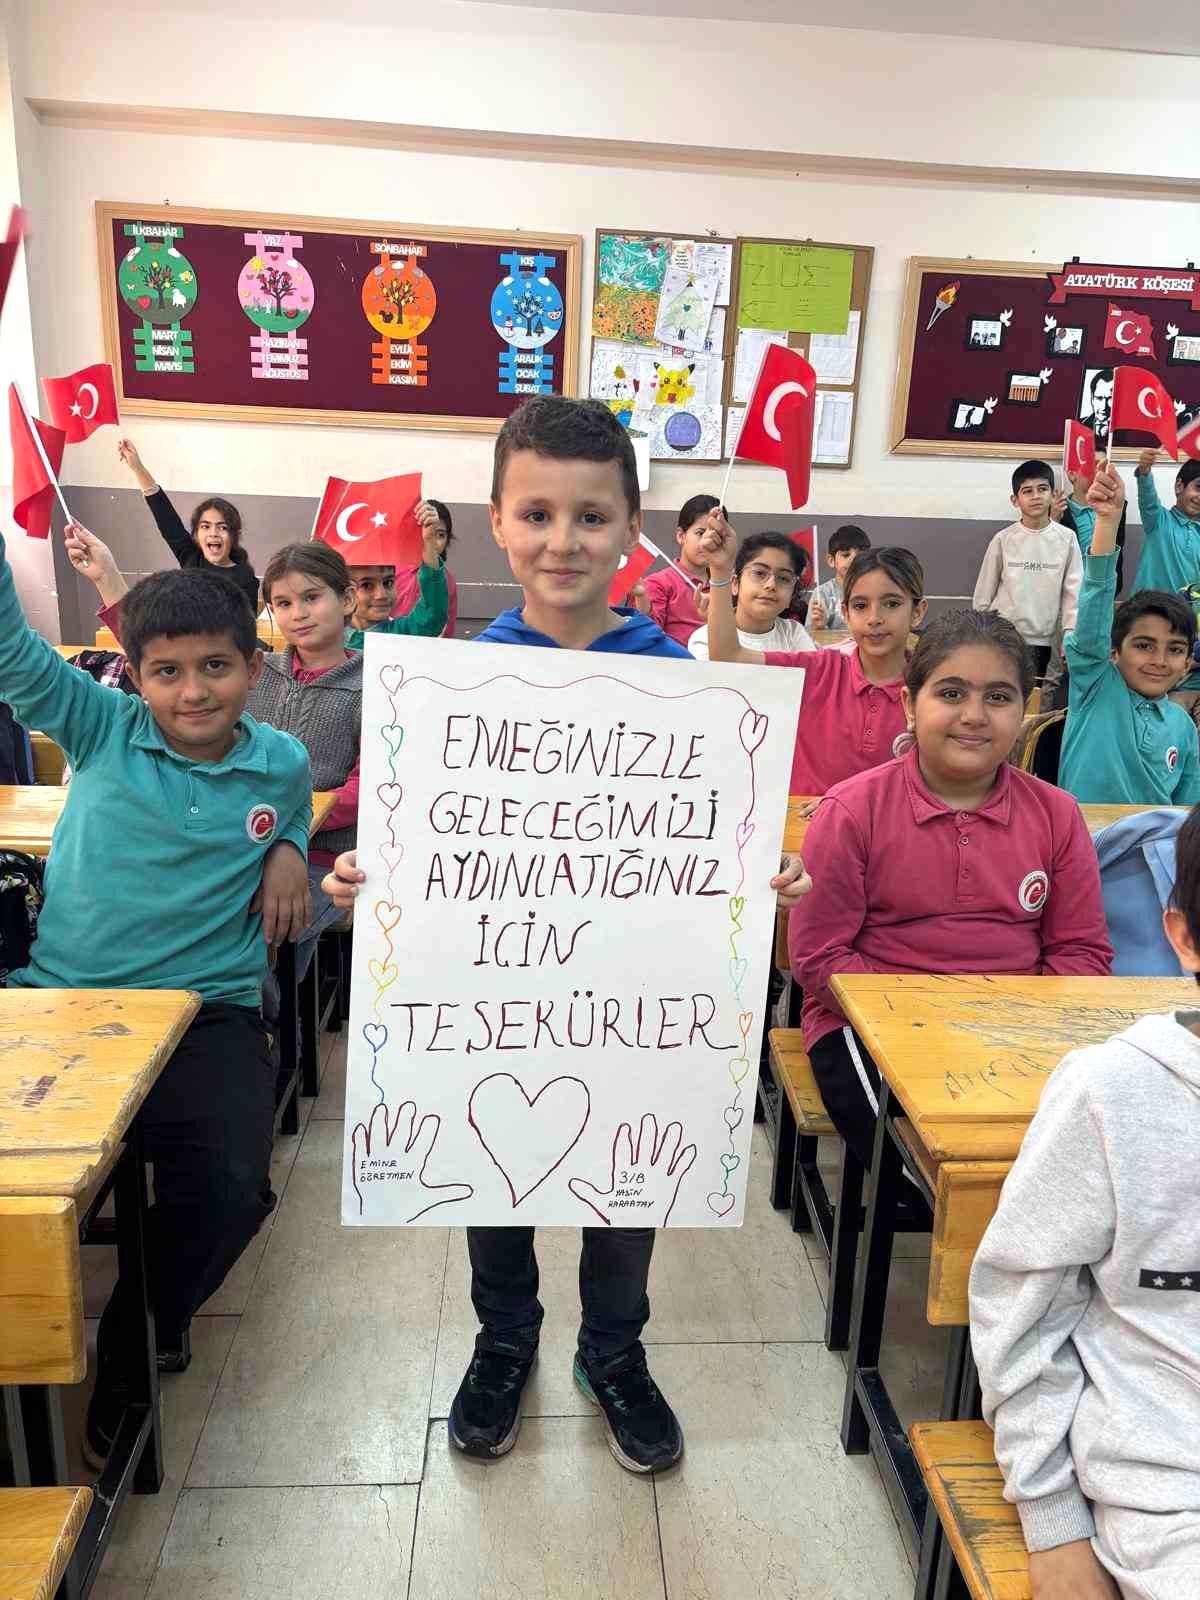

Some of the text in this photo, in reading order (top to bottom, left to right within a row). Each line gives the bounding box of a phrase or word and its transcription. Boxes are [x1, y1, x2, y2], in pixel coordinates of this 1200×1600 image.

[132, 224, 177, 237] İLKBAHAR
[1064, 272, 1195, 295] ATATÜRK KÖŞESİ
[151, 330, 180, 341] MART
[390, 359, 413, 369] EKİM
[515, 369, 540, 378] OCAK
[443, 714, 705, 779] EMEĞİNİZLE
[429, 790, 719, 842] GELECEĞİMİZİ
[619, 1171, 645, 1184] 3/B
